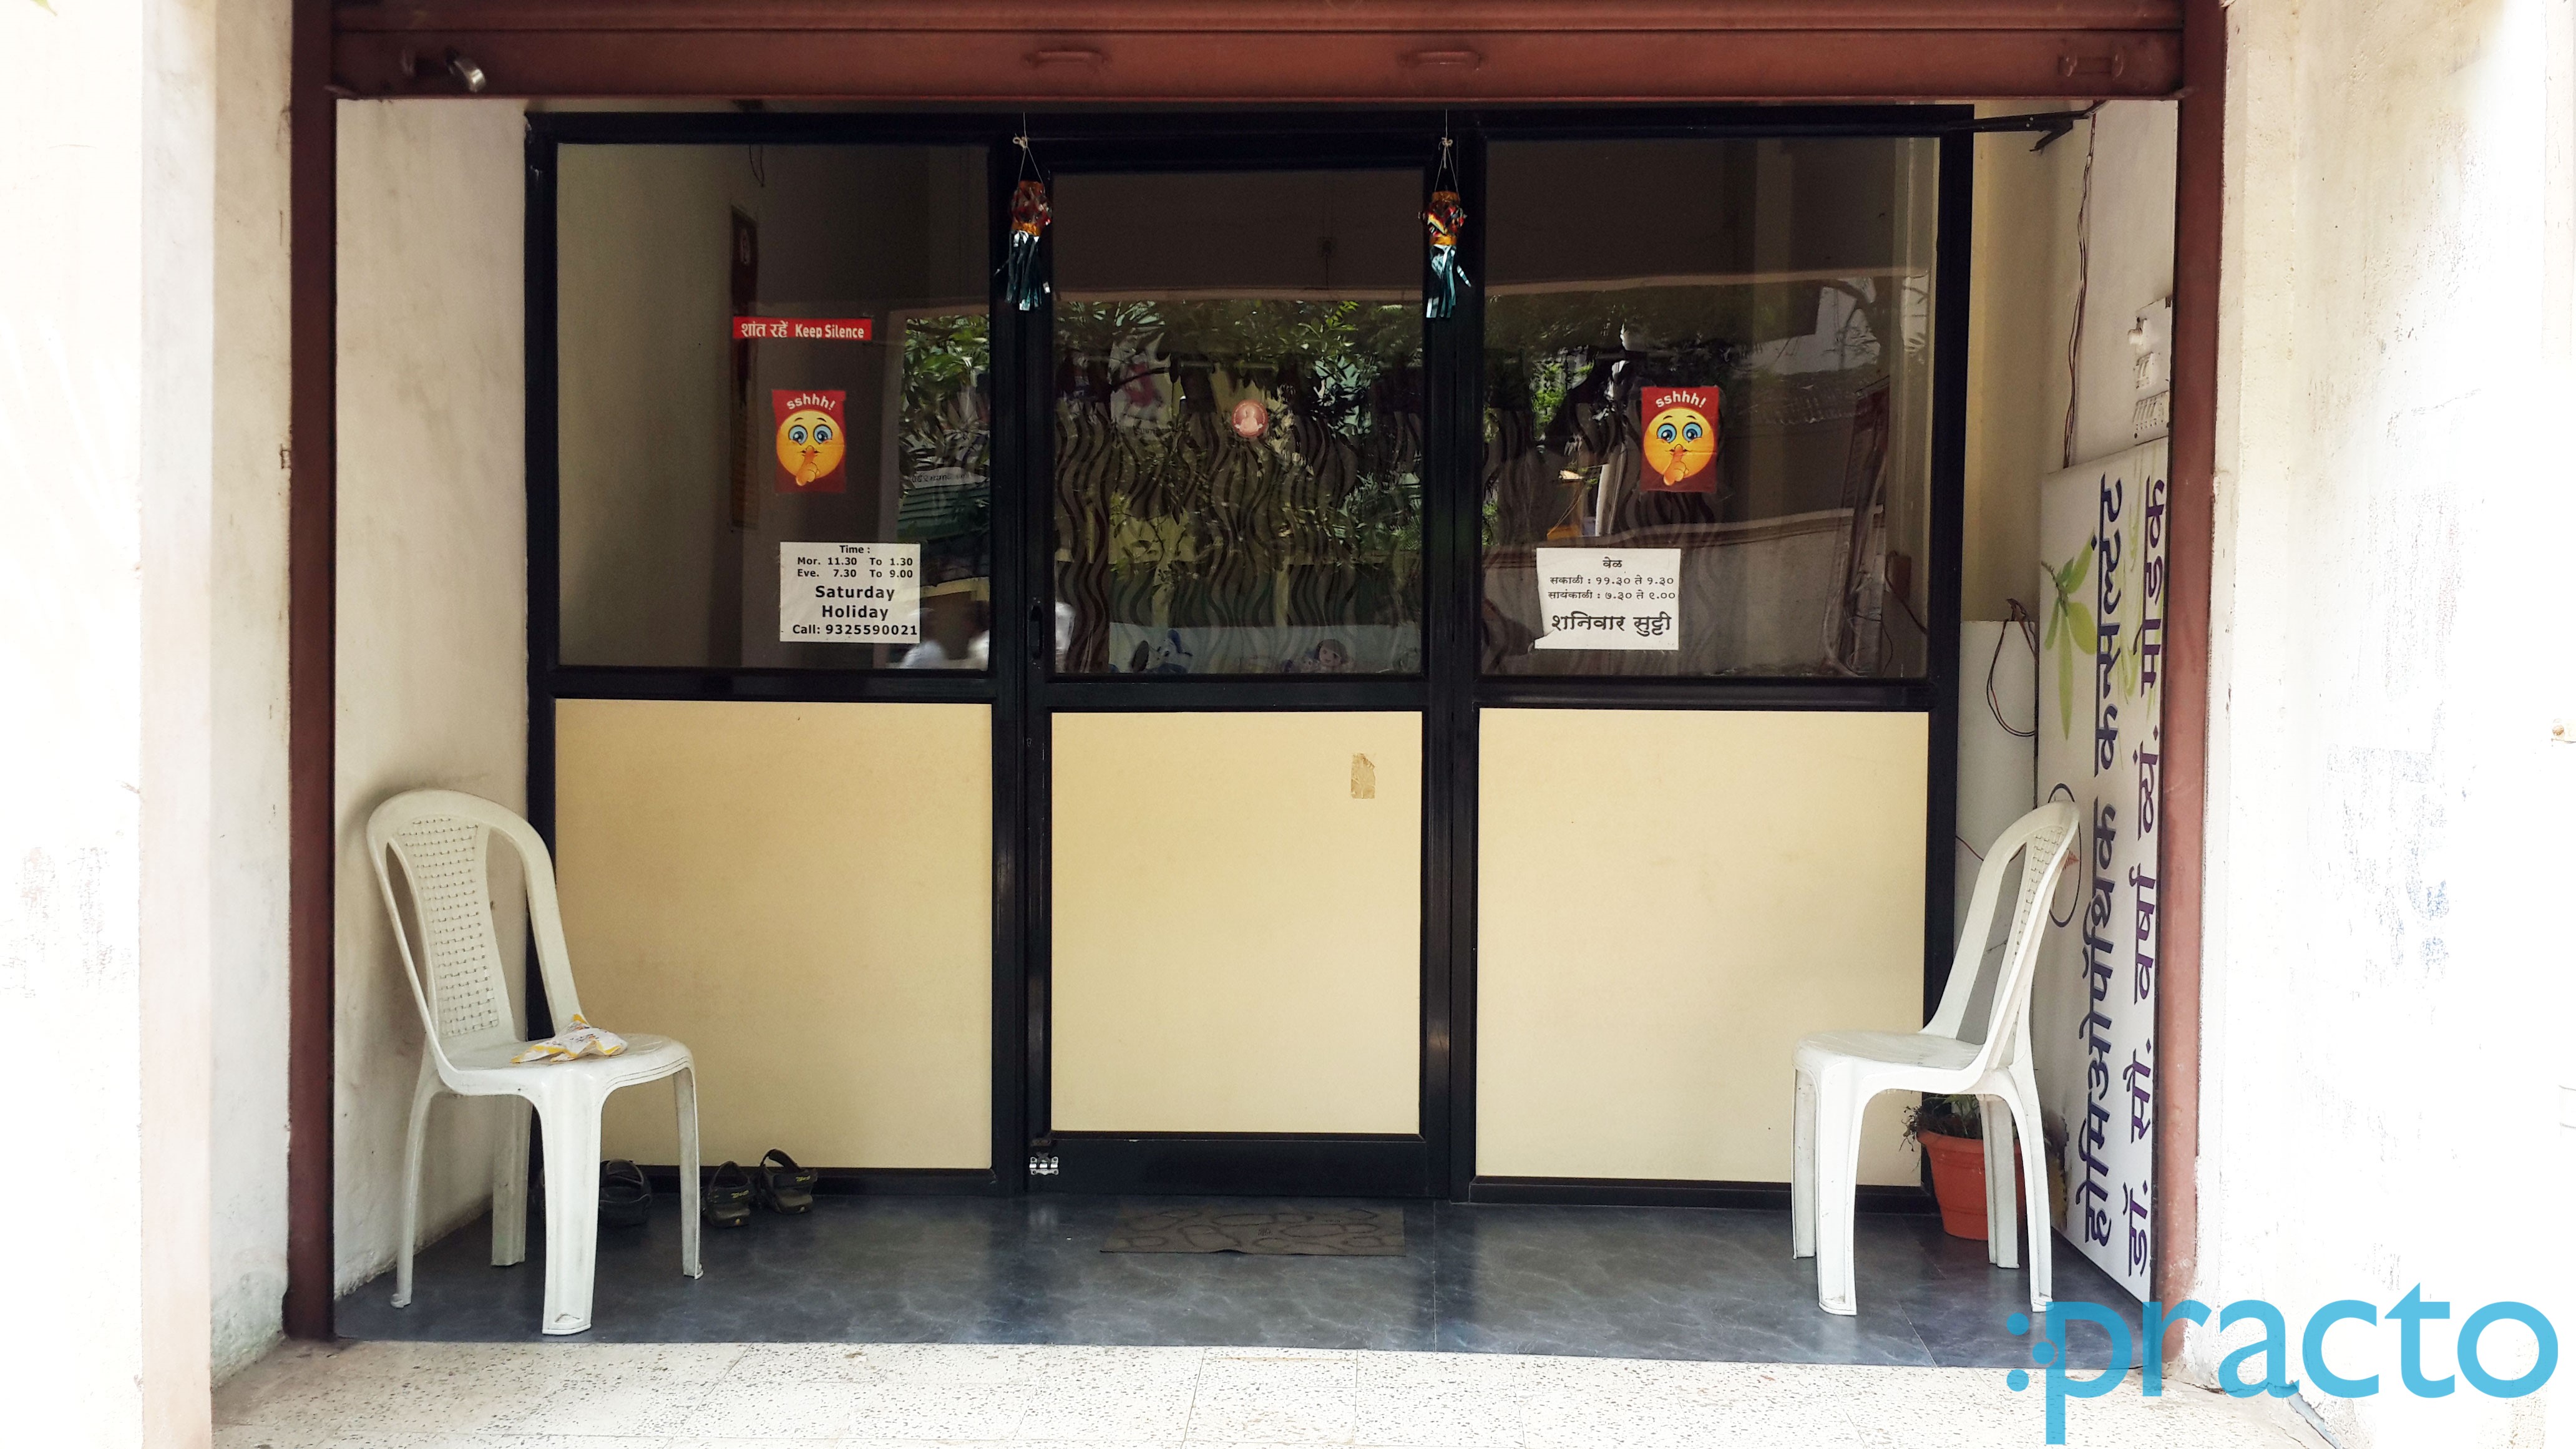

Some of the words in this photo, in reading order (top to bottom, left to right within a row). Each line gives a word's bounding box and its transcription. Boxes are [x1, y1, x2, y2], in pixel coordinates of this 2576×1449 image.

[741, 320, 767, 338] शांत
[770, 320, 789, 338] रहें
[795, 323, 823, 339] Keep
[825, 324, 865, 339] Silence
[786, 393, 836, 411] sshhh!
[1656, 390, 1707, 408] sshhh!
[839, 545, 864, 554] Time
[797, 557, 821, 565] Mor.
[827, 557, 857, 566] 11.30
[869, 557, 882, 566] To
[889, 557, 913, 566] 1.30
[1603, 557, 1622, 568] वेळ
[797, 568, 819, 577] Eve.
[833, 568, 857, 578] 7.30
[869, 569, 882, 578] To
[889, 569, 913, 578] 9.00
[1550, 575, 1583, 585] सकाळी
[1596, 577, 1631, 585] ११.३०
[1634, 575, 1642, 585] ते
[1647, 577, 1674, 586] १.३०
[815, 585, 895, 601] Saturday
[1548, 588, 1593, 599] सायंकाळी
[1605, 592, 1632, 600] ७.३०
[1636, 590, 1644, 600] ते
[2133, 475, 2165, 698] मोडक
[822, 605, 889, 621] Holiday
[793, 624, 821, 634] Call:
[826, 625, 917, 635] 9325590021
[1551, 610, 1626, 632] शनिवार
[1633, 611, 1672, 637] सुट्टी
[2090, 472, 2122, 778] कन्सल्टंट
[2132, 724, 2159, 841] व्यं.
[2129, 863, 2156, 1004] वर्षा
[2075, 796, 2116, 1247] होमिओपॅथिक
[2122, 1037, 2152, 1144] सौ.
[2122, 1180, 2148, 1277] डॉ.
